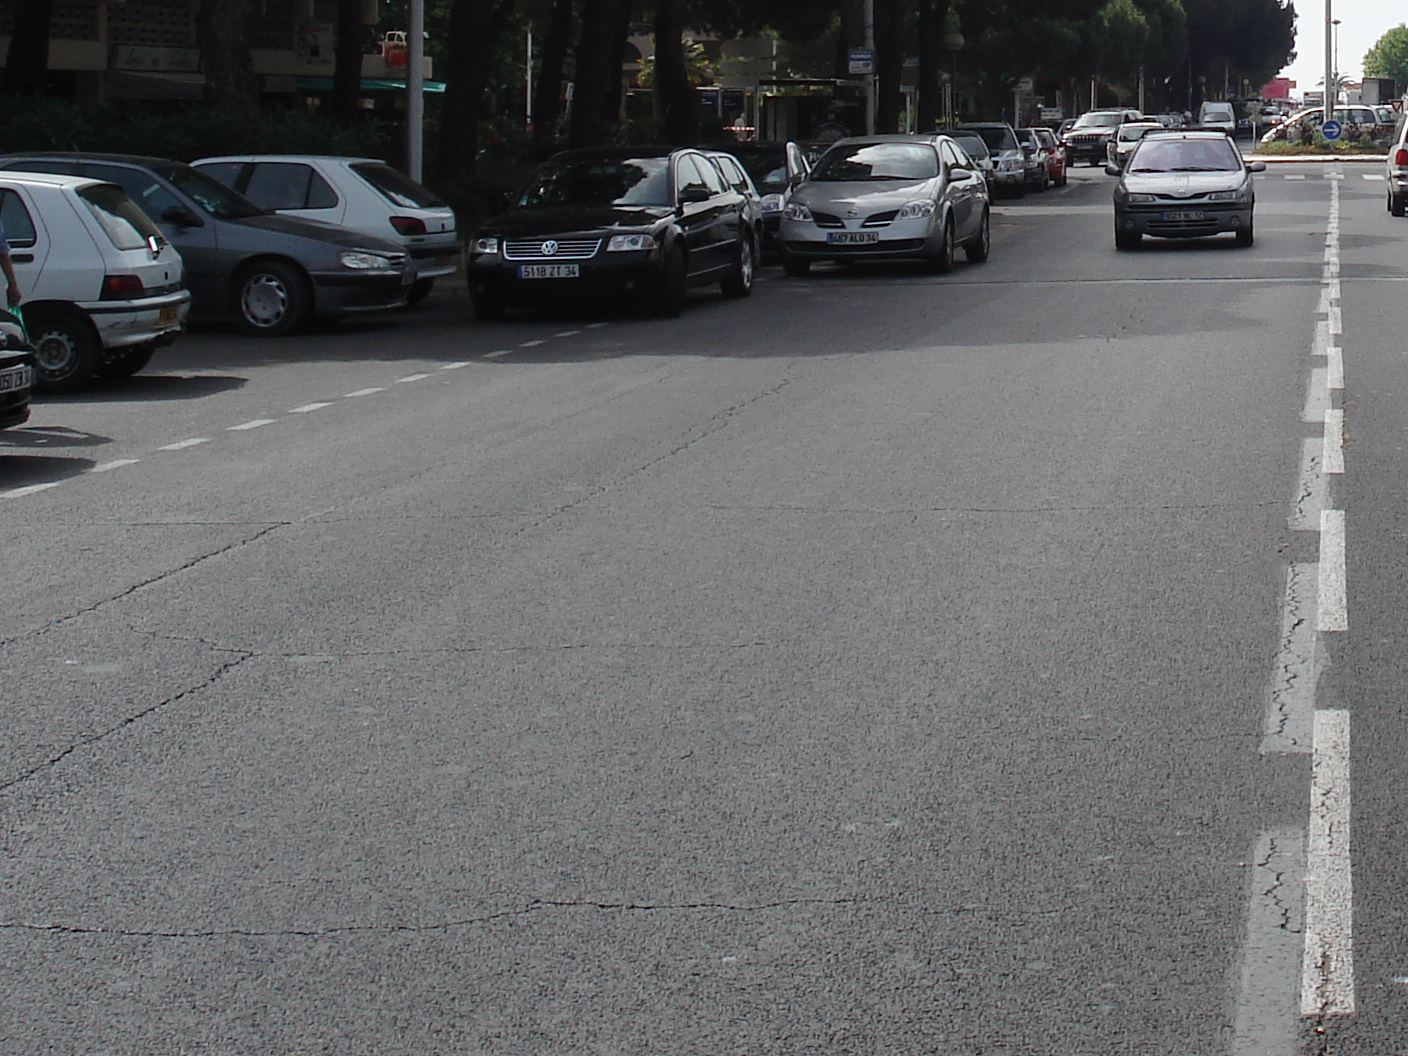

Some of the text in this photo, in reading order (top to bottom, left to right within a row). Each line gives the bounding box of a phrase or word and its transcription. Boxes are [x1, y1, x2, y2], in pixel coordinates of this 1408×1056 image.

[866, 233, 877, 242] 34
[549, 266, 561, 277] ZT
[565, 266, 577, 276] 34
